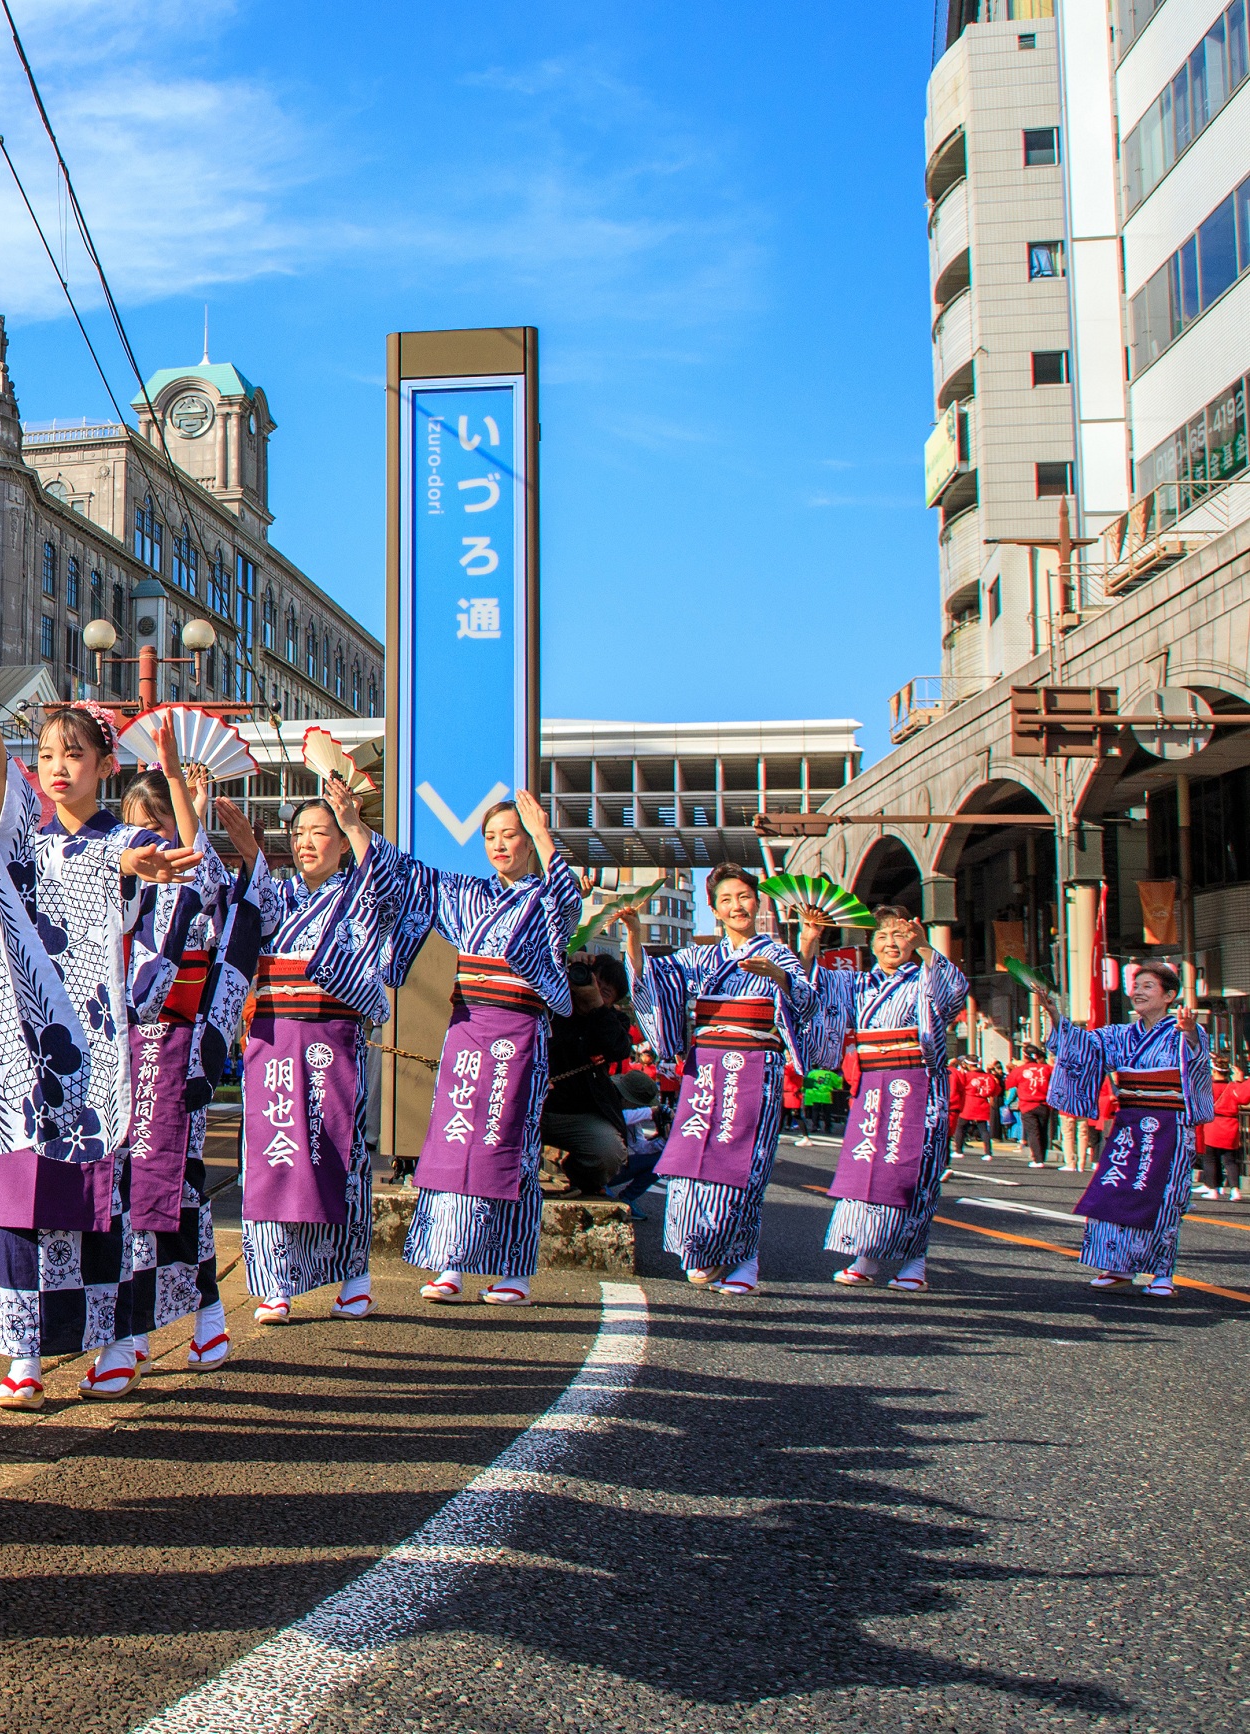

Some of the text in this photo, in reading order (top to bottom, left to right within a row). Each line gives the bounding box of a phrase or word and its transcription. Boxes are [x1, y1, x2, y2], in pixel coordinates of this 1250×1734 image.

[427, 416, 445, 516] Izuro-dori
[456, 415, 502, 640] いづろ通
[129, 1042, 161, 1159] 若柳流同志会
[308, 1070, 326, 1165] 若柳流同志会
[482, 1061, 509, 1146] 若柳流同志会
[716, 1071, 740, 1144] 若柳流同志会
